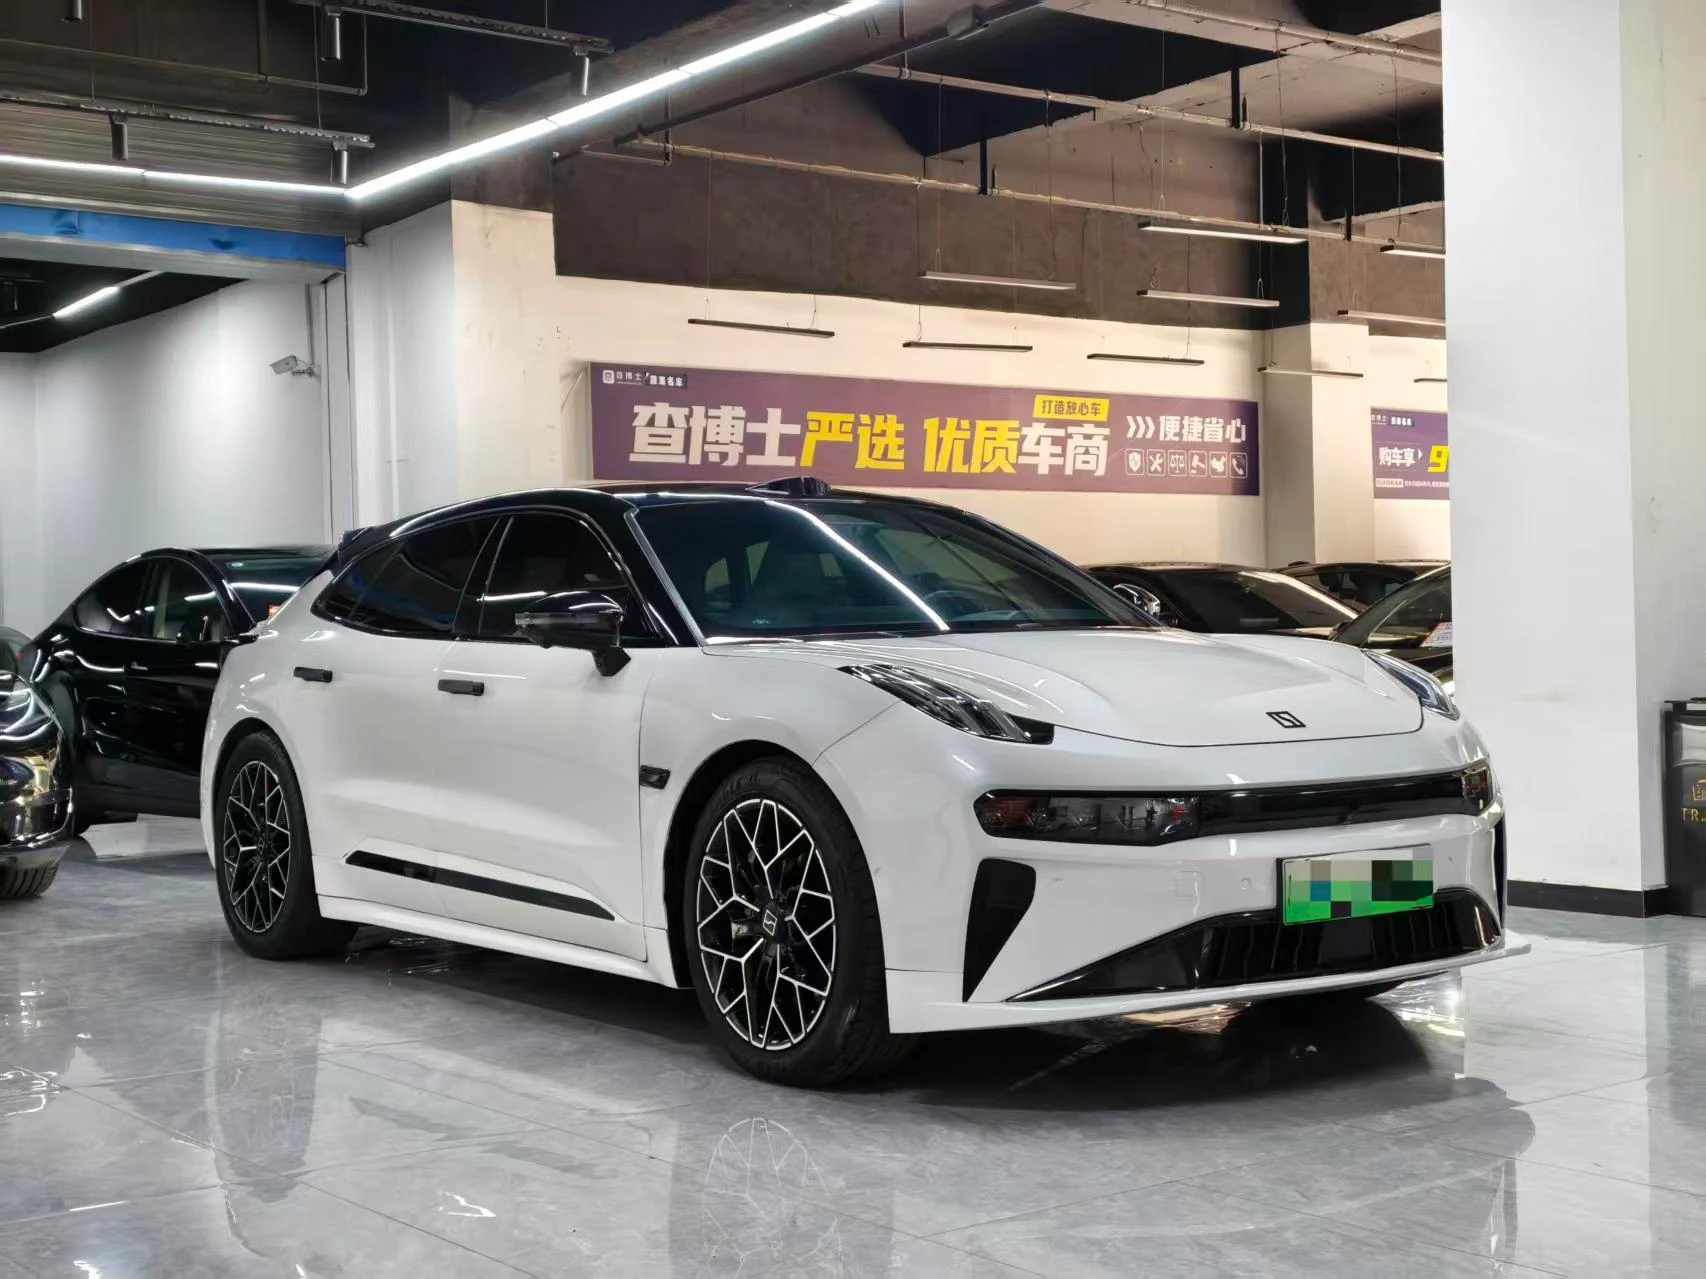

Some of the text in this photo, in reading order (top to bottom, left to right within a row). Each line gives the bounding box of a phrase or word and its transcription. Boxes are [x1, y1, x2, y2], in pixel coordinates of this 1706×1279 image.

[1041, 399, 1102, 417] 打造放心车
[629, 402, 1110, 476] 查博士严选 优质车商
[1159, 415, 1247, 444] 便捷省心
[1680, 807, 1706, 822] TR
